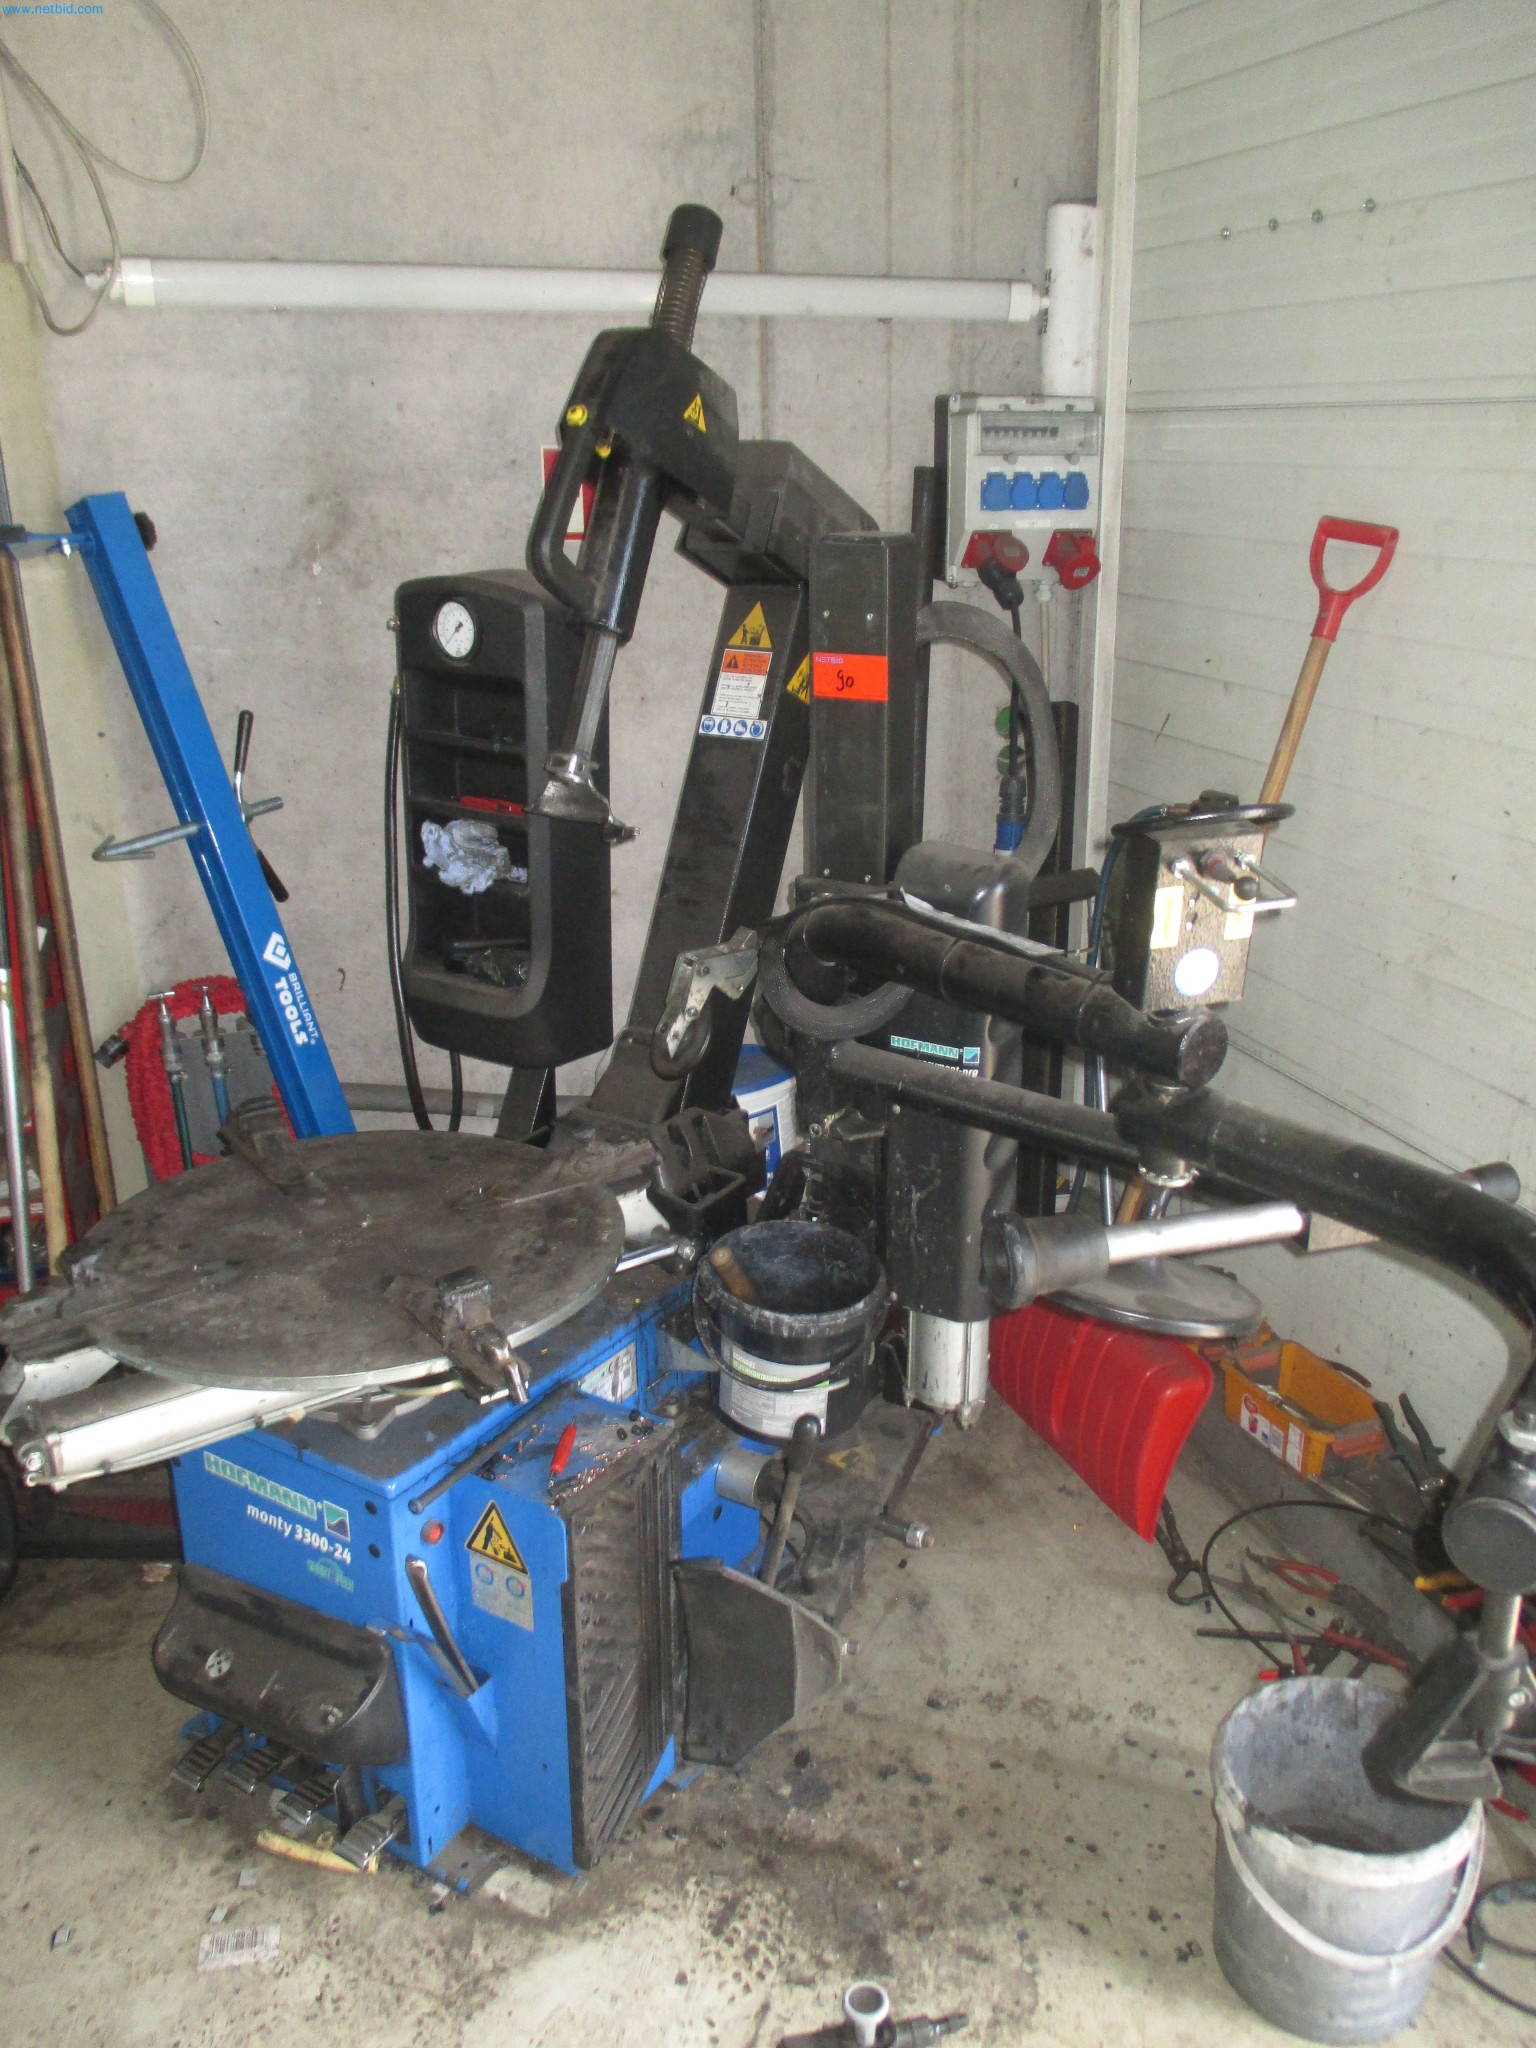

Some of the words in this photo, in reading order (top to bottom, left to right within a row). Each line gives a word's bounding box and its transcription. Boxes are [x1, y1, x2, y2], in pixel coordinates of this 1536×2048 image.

[274, 976, 309, 1046] TOOLS
[288, 972, 319, 1038] BRILLIANT
[890, 1034, 960, 1060] HOFMANN
[203, 1450, 318, 1522] HOFMANN
[246, 1503, 293, 1538] monty
[294, 1523, 352, 1566] 3300-24
